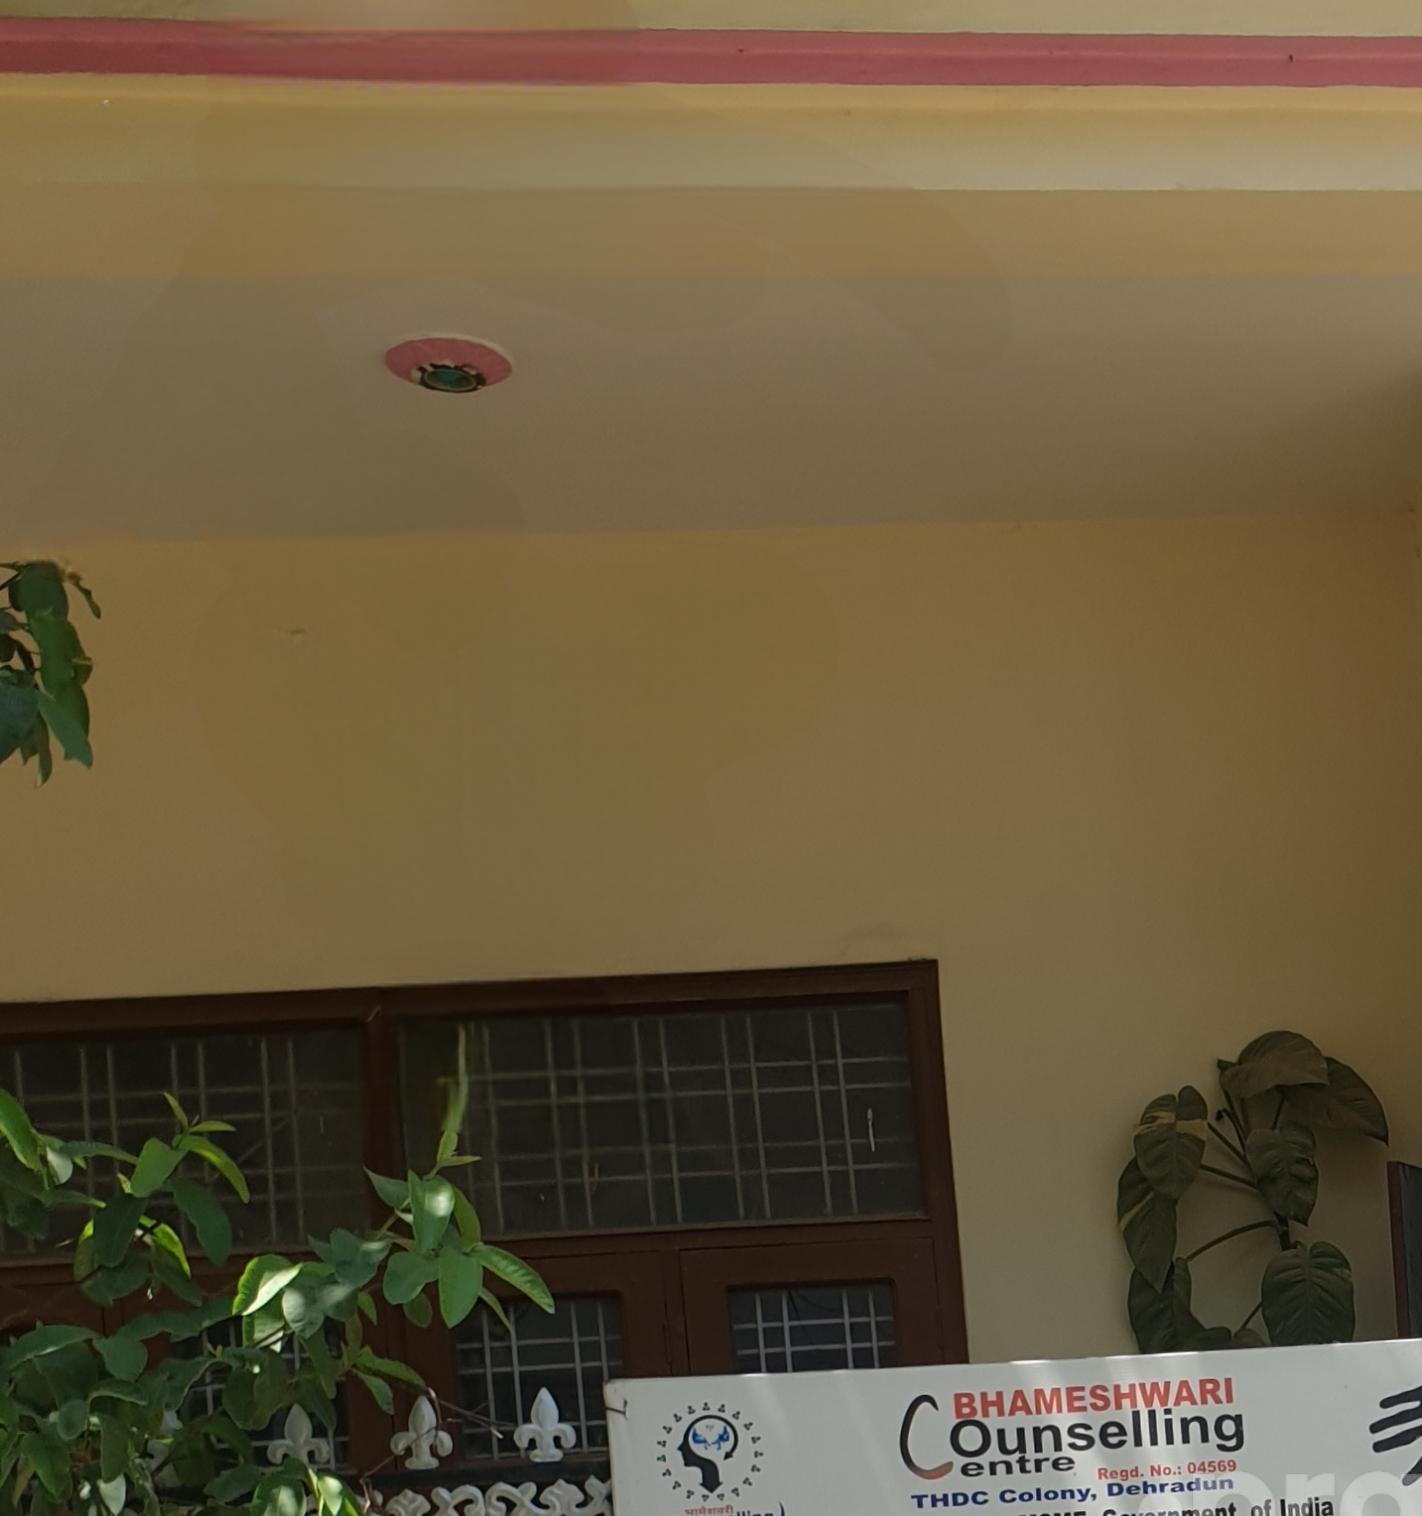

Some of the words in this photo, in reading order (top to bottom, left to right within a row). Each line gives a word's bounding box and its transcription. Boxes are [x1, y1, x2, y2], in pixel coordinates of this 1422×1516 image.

[952, 1376, 1235, 1420] BHAMESHWARI
[1097, 1465, 1145, 1481] Regd.
[1186, 1459, 1238, 1474] 04569
[910, 1490, 991, 1510] THDC
[998, 1484, 1098, 1505] Colony,
[1106, 1475, 1236, 1498] Dehradun
